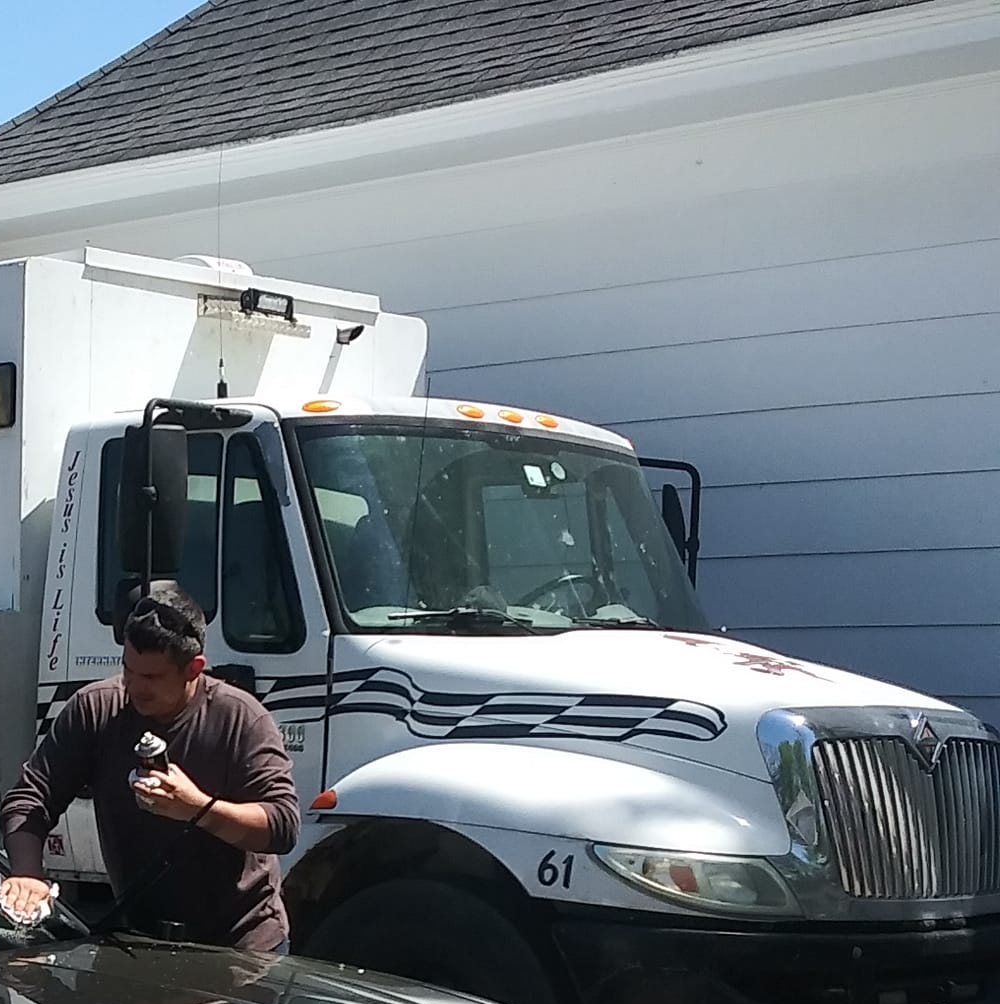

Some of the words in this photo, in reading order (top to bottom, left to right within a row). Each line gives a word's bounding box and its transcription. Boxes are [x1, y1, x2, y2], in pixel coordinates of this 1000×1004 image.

[60, 449, 81, 534] Jesus
[56, 542, 66, 579] is
[47, 589, 64, 671] Life
[537, 849, 575, 889] 61
